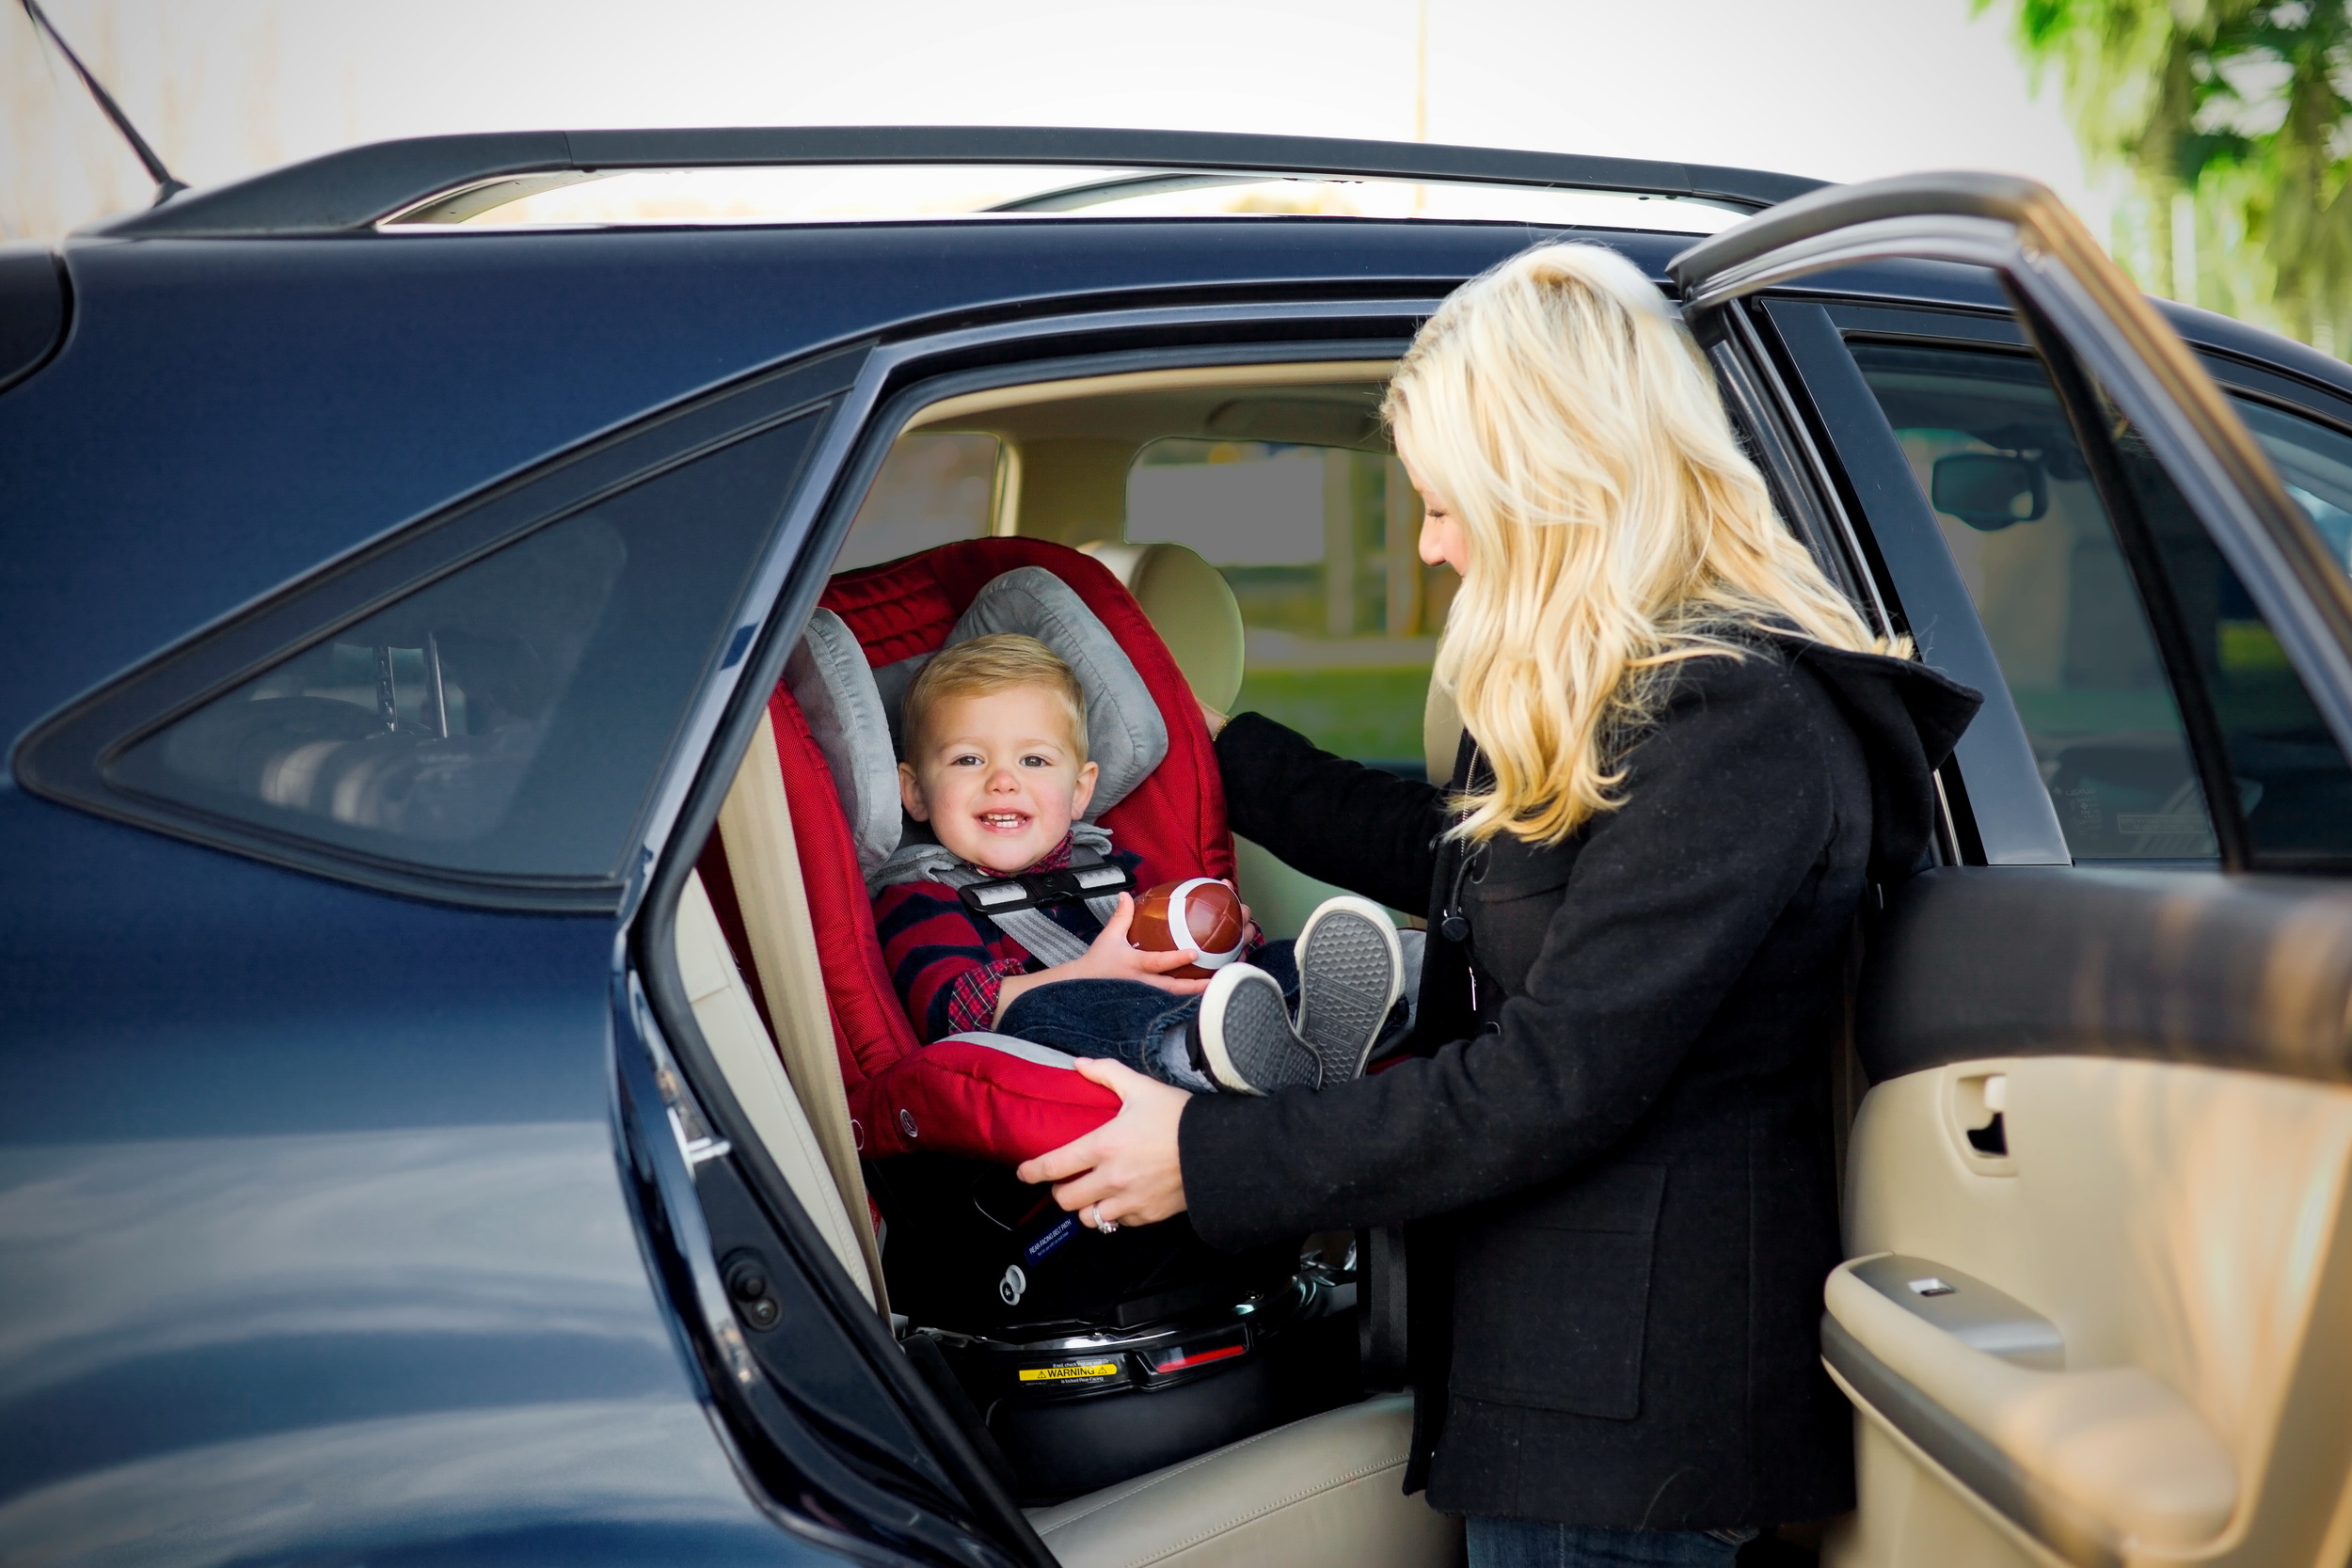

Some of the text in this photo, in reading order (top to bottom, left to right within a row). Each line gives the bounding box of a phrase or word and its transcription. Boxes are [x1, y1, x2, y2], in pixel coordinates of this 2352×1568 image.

[1028, 1232, 1054, 1255] REAR-FACING
[1052, 1226, 1062, 1238] BELT
[1060, 1219, 1073, 1230] PATH
[1047, 1367, 1095, 1378] WARNING
